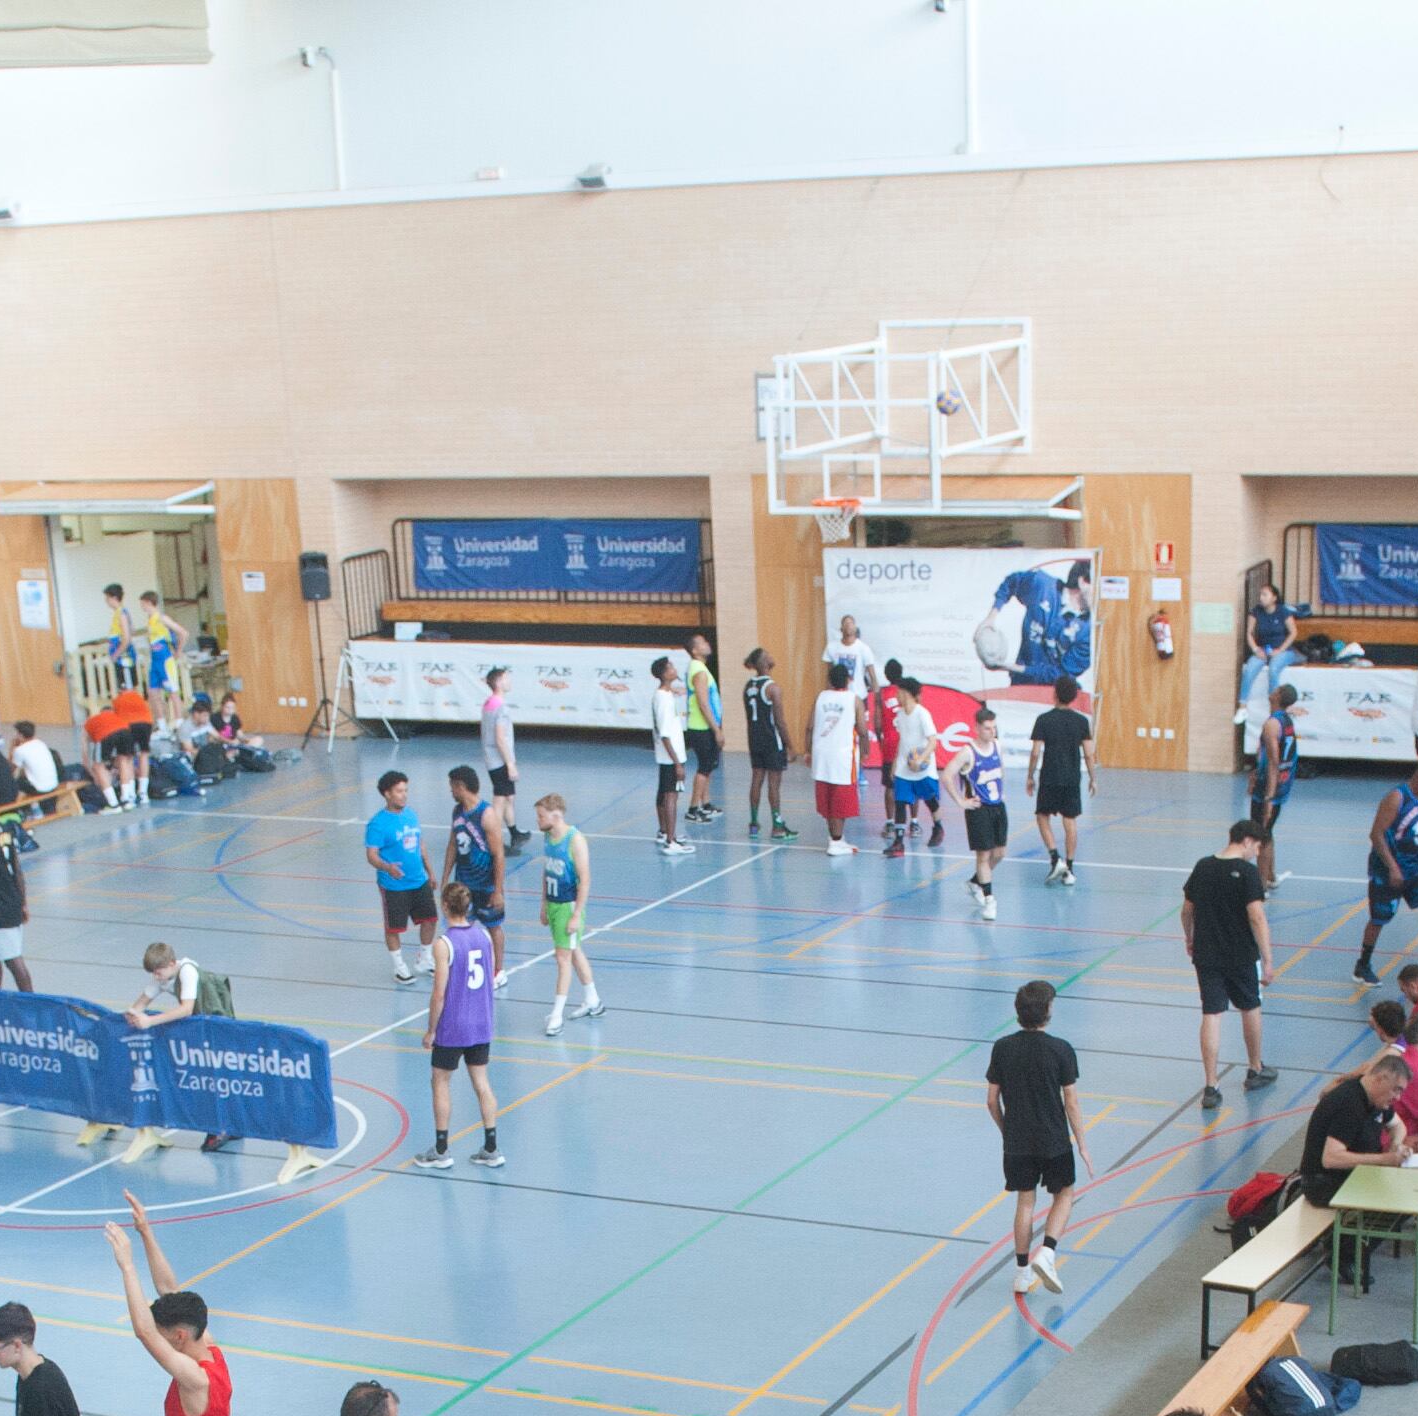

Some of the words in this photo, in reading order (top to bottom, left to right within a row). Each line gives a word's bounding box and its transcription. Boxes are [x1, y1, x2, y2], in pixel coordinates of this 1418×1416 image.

[453, 535, 539, 553] Universidad
[596, 535, 686, 553] Universidad
[457, 555, 510, 569] Zaragoza
[599, 555, 656, 570] Zaragoza
[837, 558, 932, 584] deporte
[467, 949, 484, 989] 5
[169, 1039, 312, 1081] Universidad
[176, 1069, 265, 1100] Zaragoza
